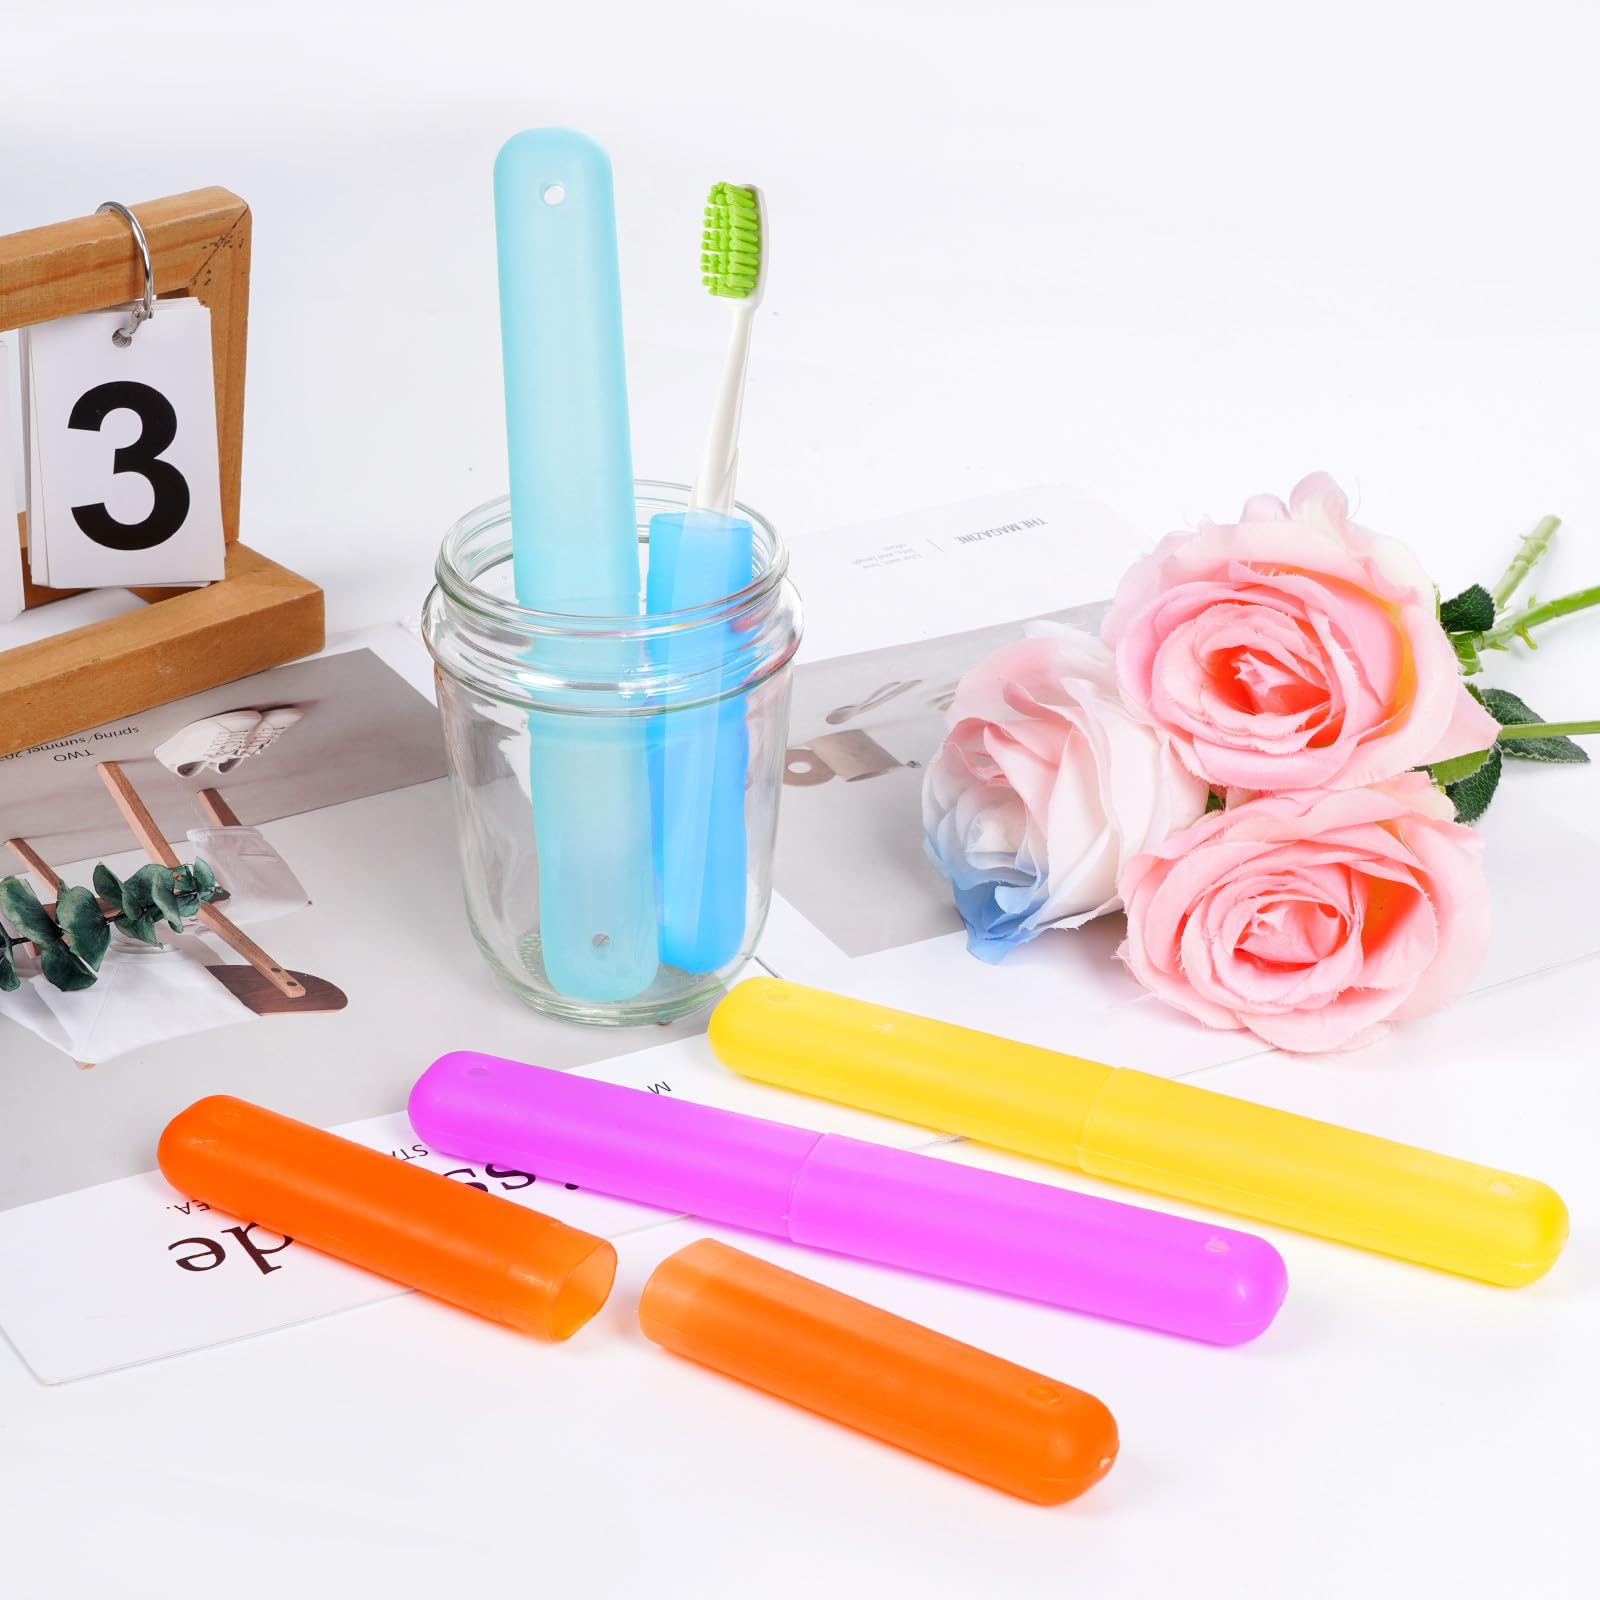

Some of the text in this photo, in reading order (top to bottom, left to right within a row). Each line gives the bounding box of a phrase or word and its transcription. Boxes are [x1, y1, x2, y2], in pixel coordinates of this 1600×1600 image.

[67, 380, 191, 551] 3
[953, 516, 1049, 545] THE MAGAZINE
[26, 726, 140, 754] spring/summer
[53, 748, 94, 762] TWO
